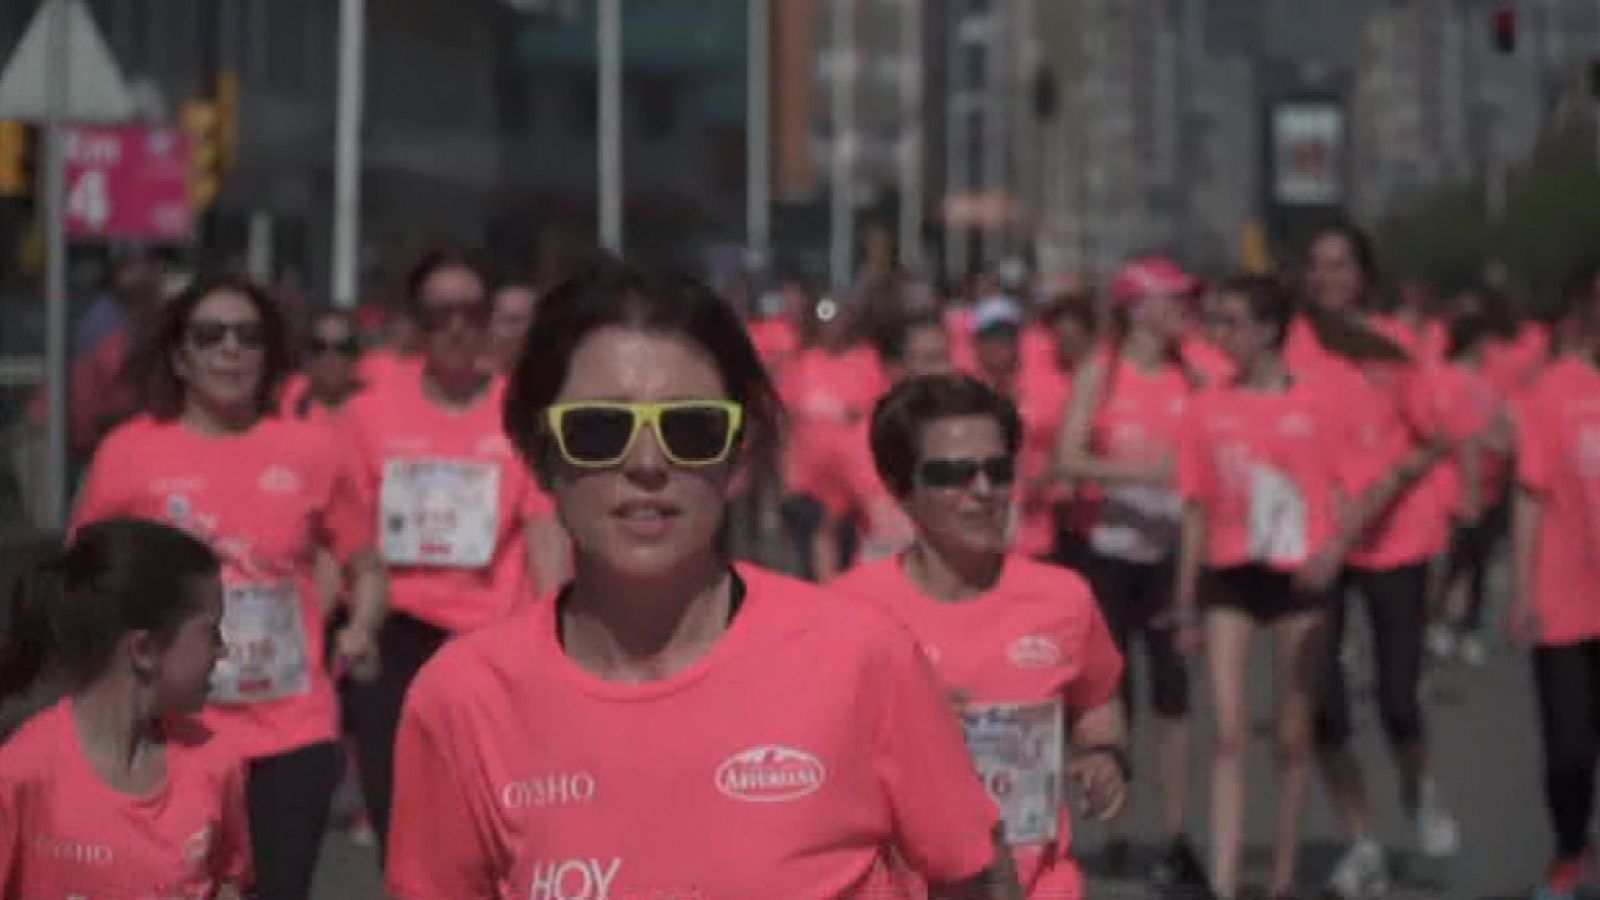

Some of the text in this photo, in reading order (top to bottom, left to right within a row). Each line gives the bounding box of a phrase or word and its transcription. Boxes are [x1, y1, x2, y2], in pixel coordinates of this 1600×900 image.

[69, 170, 108, 231] 4
[503, 771, 595, 808] OYSHO
[529, 857, 621, 900] HOY
